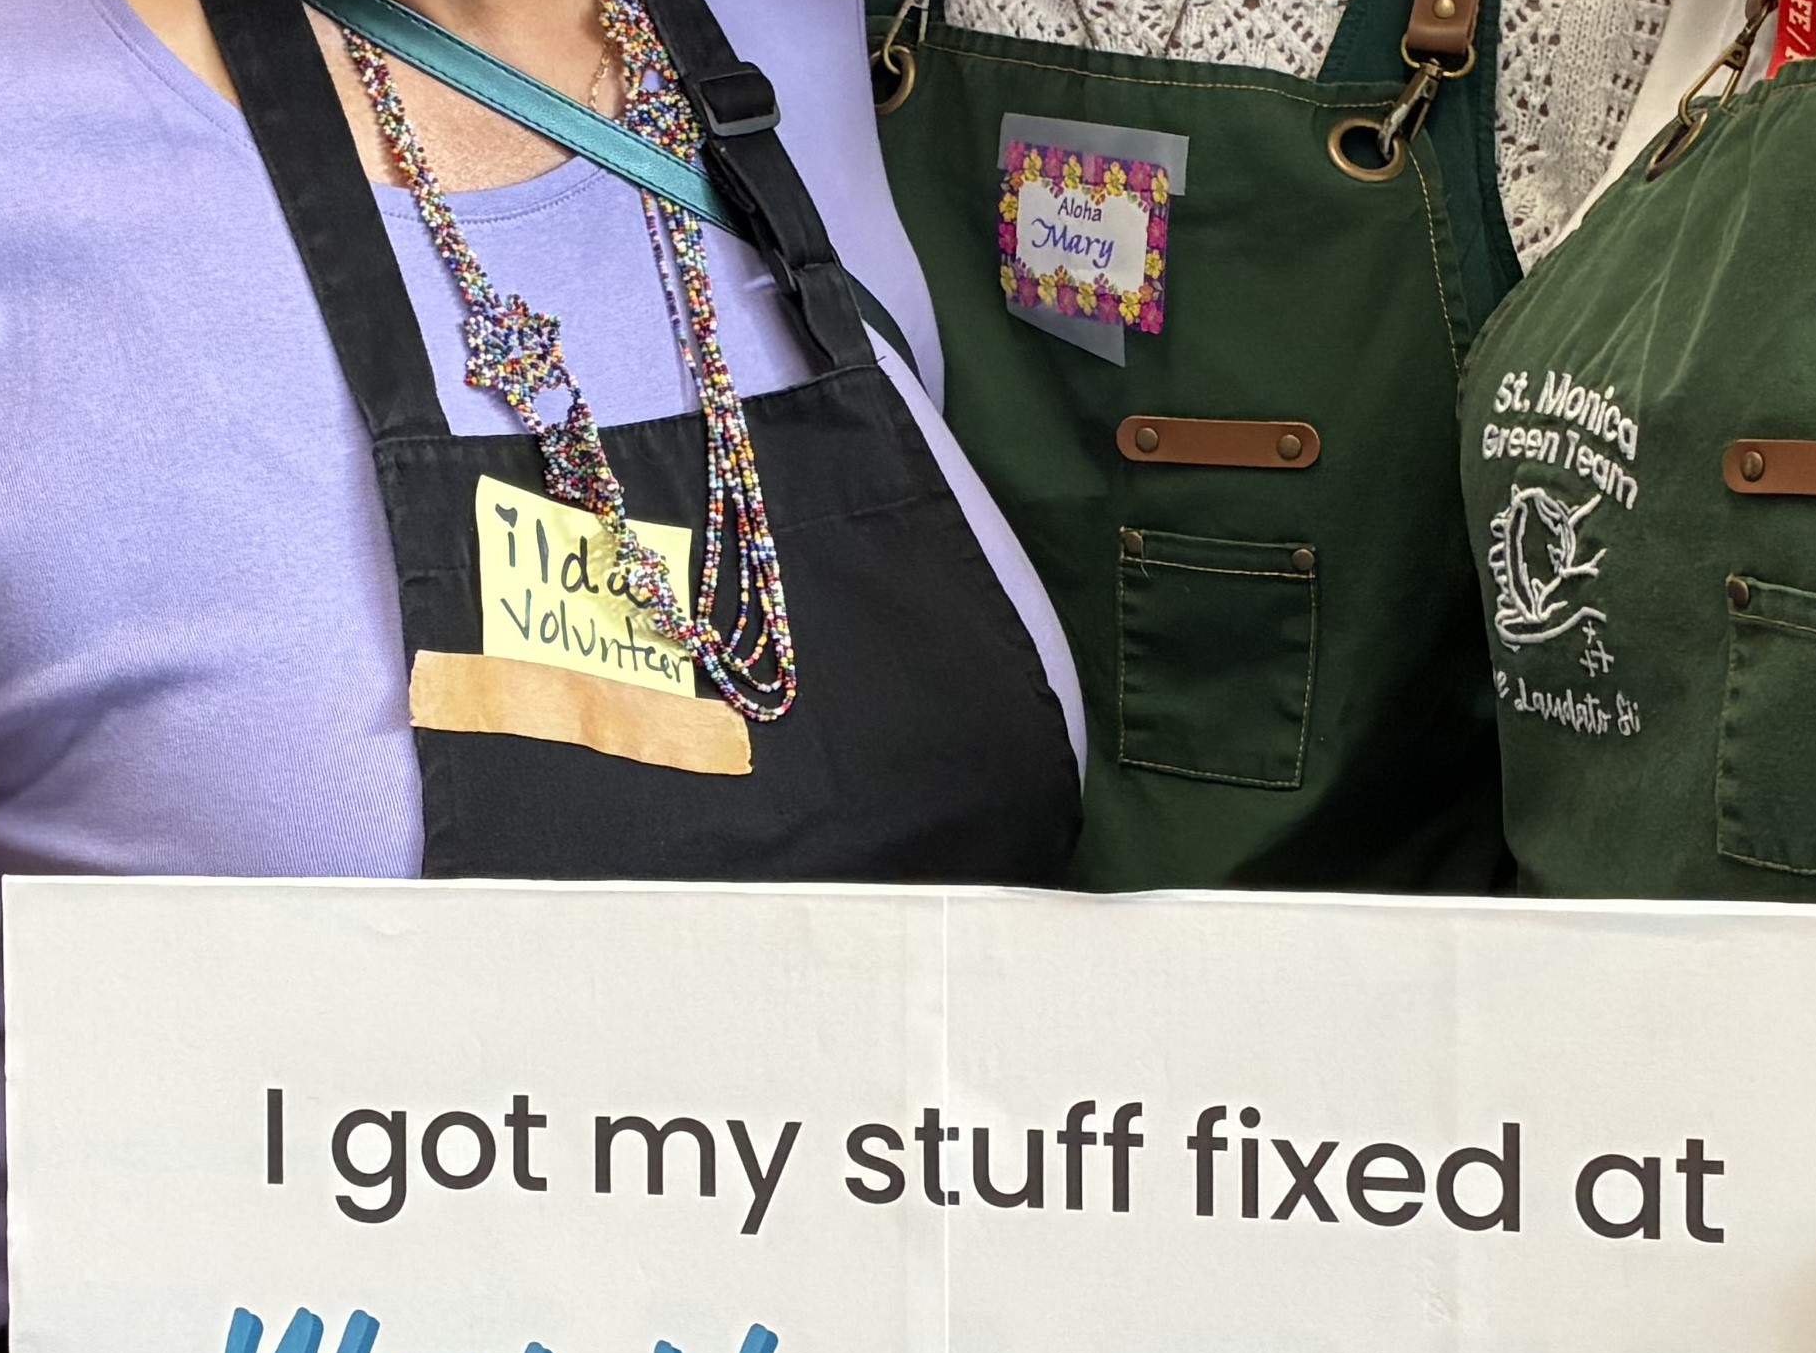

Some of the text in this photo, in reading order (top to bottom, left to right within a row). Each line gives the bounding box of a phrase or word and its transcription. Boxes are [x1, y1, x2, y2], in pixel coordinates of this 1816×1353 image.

[1031, 217, 1115, 270] Mary
[1056, 196, 1103, 222] Aloha
[1494, 369, 1639, 461] St. Monica
[1482, 422, 1639, 510] Green Team
[1513, 677, 1612, 736] Laudato
[265, 1086, 1726, 1245] I got my stuff fixed at
